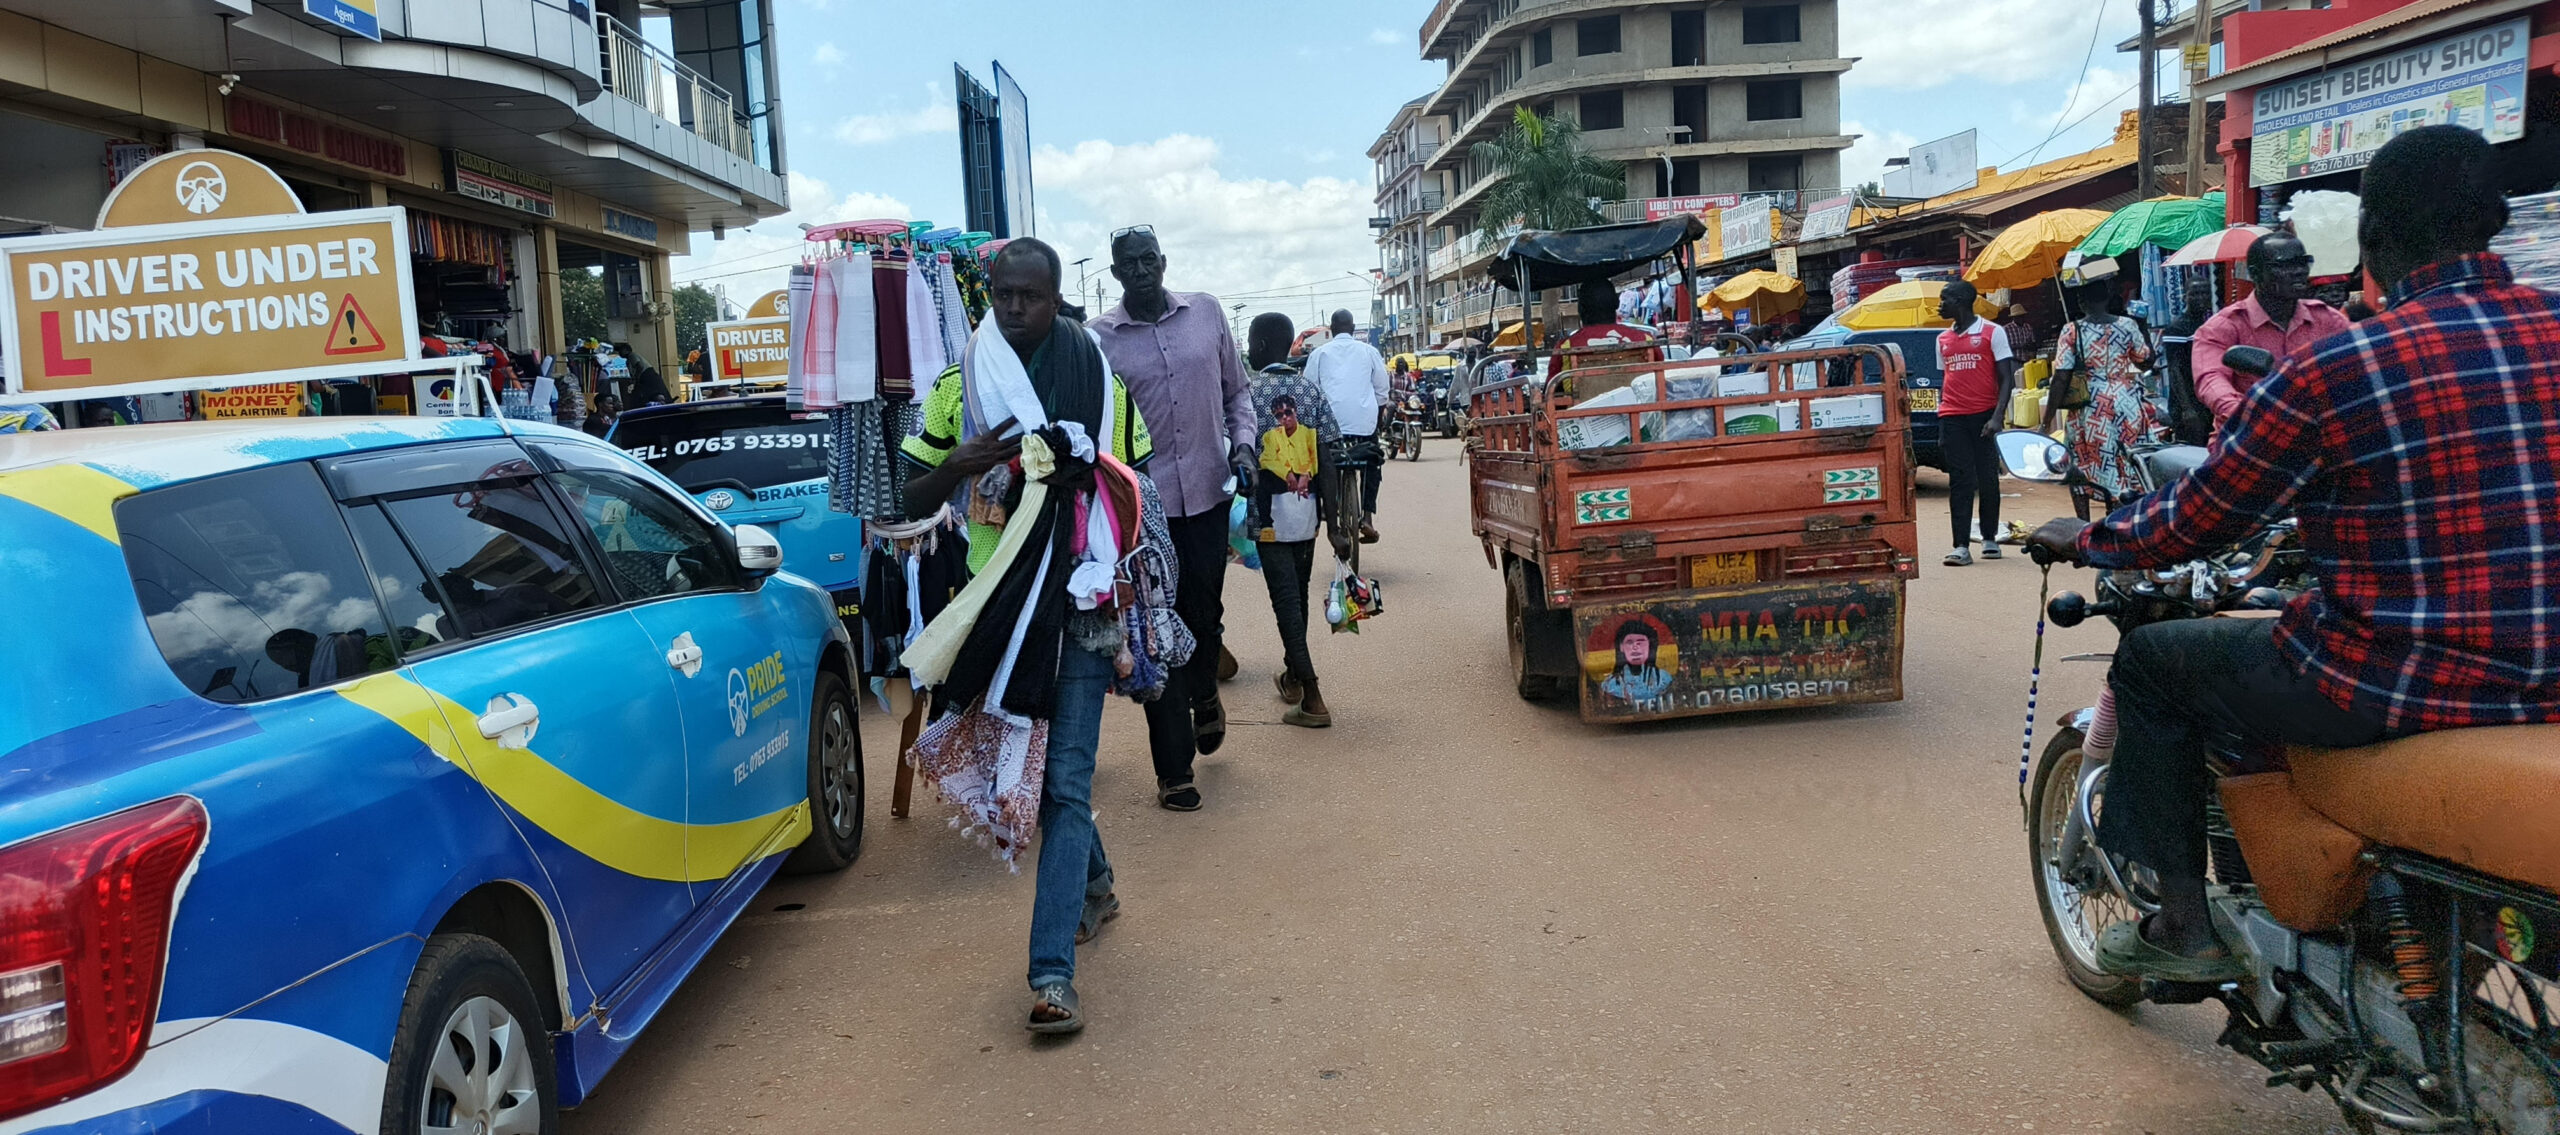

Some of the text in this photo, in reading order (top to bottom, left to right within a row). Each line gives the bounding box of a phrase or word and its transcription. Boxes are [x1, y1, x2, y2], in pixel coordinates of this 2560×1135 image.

[334, 4, 355, 24] Agent
[2258, 29, 2515, 116] SUNSET BEAUTY SHOP
[2255, 116, 2297, 132] WHOLESALE
[2297, 113, 2314, 123] AND
[2315, 107, 2340, 119] RETAIL
[2347, 100, 2372, 112] Dealers
[2383, 88, 2420, 104] Cosmetics
[2421, 84, 2436, 94] and
[2438, 76, 2469, 91] General
[2471, 62, 2522, 84] machandise
[2343, 155, 2353, 167] 70
[28, 238, 380, 300] DRIVER UNDER
[40, 291, 330, 377] L INSTRUCTIONS
[717, 329, 786, 347] DRIVER
[722, 346, 790, 376] L INSTRUC
[231, 382, 297, 395] MOBILE
[1916, 389, 1934, 399] UBJ
[207, 395, 297, 408] MONEY
[1912, 399, 1934, 409] 256C
[216, 407, 288, 418] ALL AIRTIME
[675, 436, 736, 455] 0763
[758, 483, 829, 503] BRAKES
[1716, 552, 1747, 569] UEZ
[1699, 608, 1780, 651] MIA
[746, 650, 786, 702] PRIDE
[751, 687, 788, 719] DRIVING SCHOOL
[1695, 680, 1849, 709] 0760158877
[733, 729, 789, 786] TEL: 0763 933915
